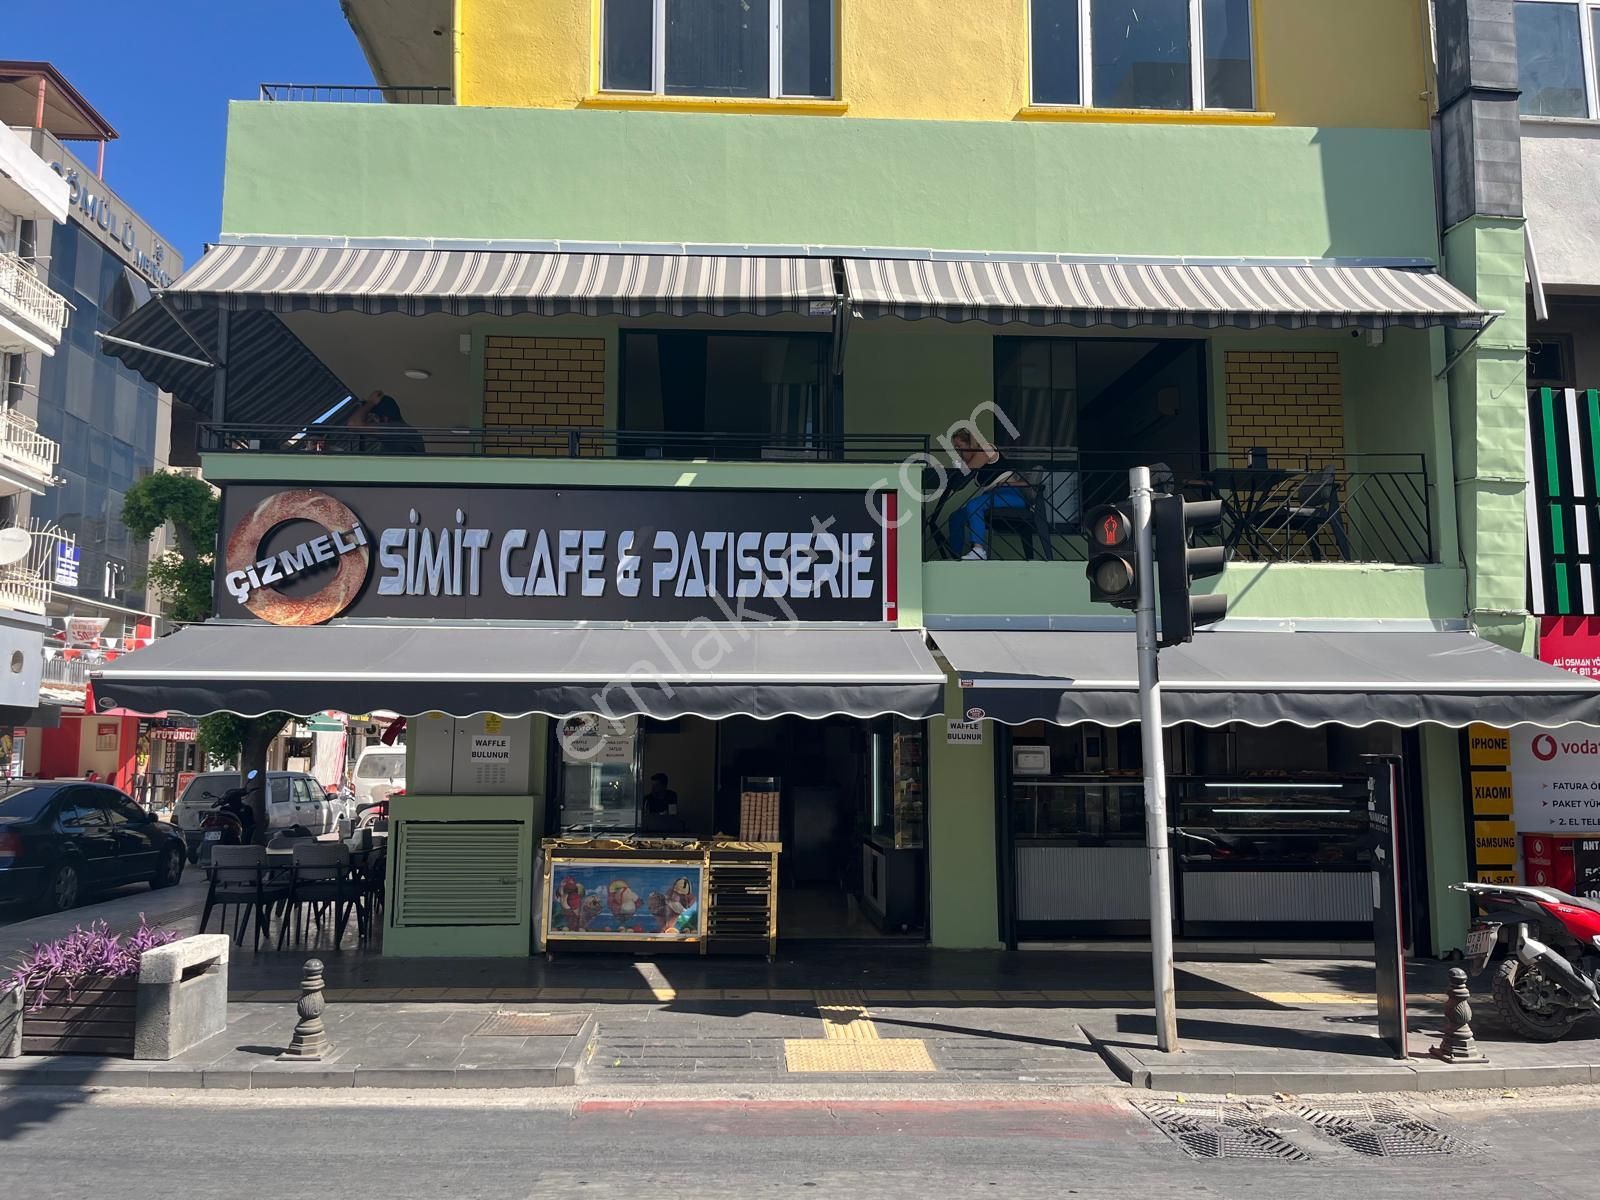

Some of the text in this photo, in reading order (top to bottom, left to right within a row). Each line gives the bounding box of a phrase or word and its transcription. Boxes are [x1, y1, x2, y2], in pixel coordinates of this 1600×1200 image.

[377, 508, 875, 599] SİMİT CAFE & PATISSERIE
[225, 522, 369, 604] ÇİZMELİ
[1553, 657, 1564, 667] ALİ
[1565, 658, 1590, 667] OSMAN
[950, 722, 979, 730] WAFFLE
[947, 733, 982, 741] BULUNUR
[475, 739, 506, 747] WAFFLE
[1471, 737, 1507, 750] IPHONE
[471, 751, 509, 759] BULUNUR
[1553, 780, 1600, 790] FATURA Ö
[1475, 786, 1511, 799] XIAOMI
[1552, 800, 1581, 808] PAKET
[1568, 817, 1579, 826] EL
[1476, 837, 1515, 849] SAMSUNG
[1480, 875, 1515, 885] AL-SAT
